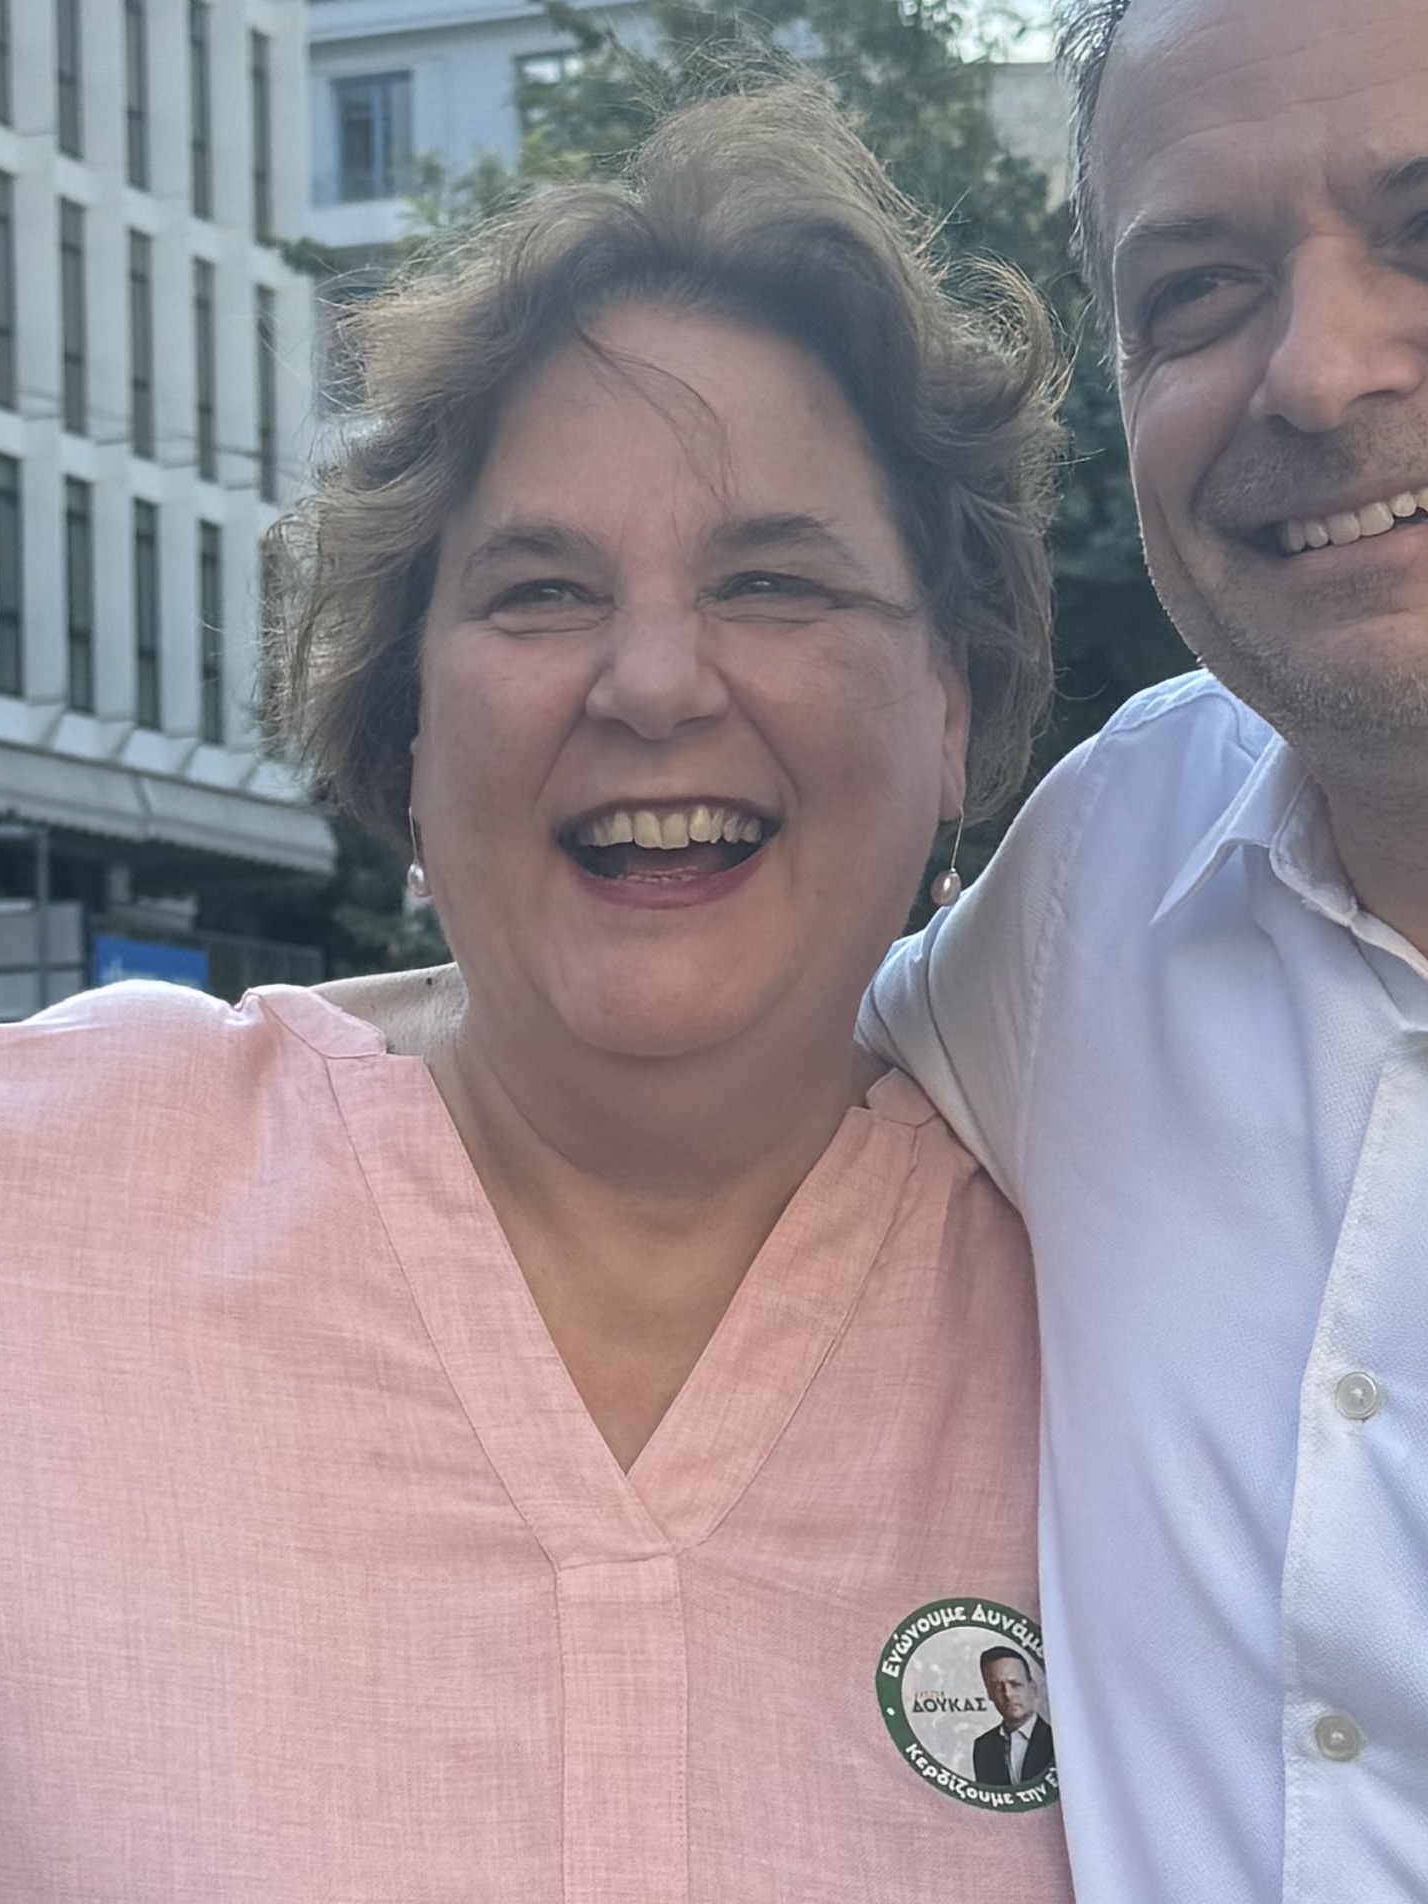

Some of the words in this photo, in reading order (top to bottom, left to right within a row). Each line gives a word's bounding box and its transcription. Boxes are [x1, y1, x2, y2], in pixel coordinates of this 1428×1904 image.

[881, 1606, 967, 1678] Ενώνουμε
[912, 1697, 988, 1713] ΔΟΥΚΑΣ
[905, 1743, 1014, 1807] Κερδίζουμε
[1016, 1783, 1047, 1802] την
